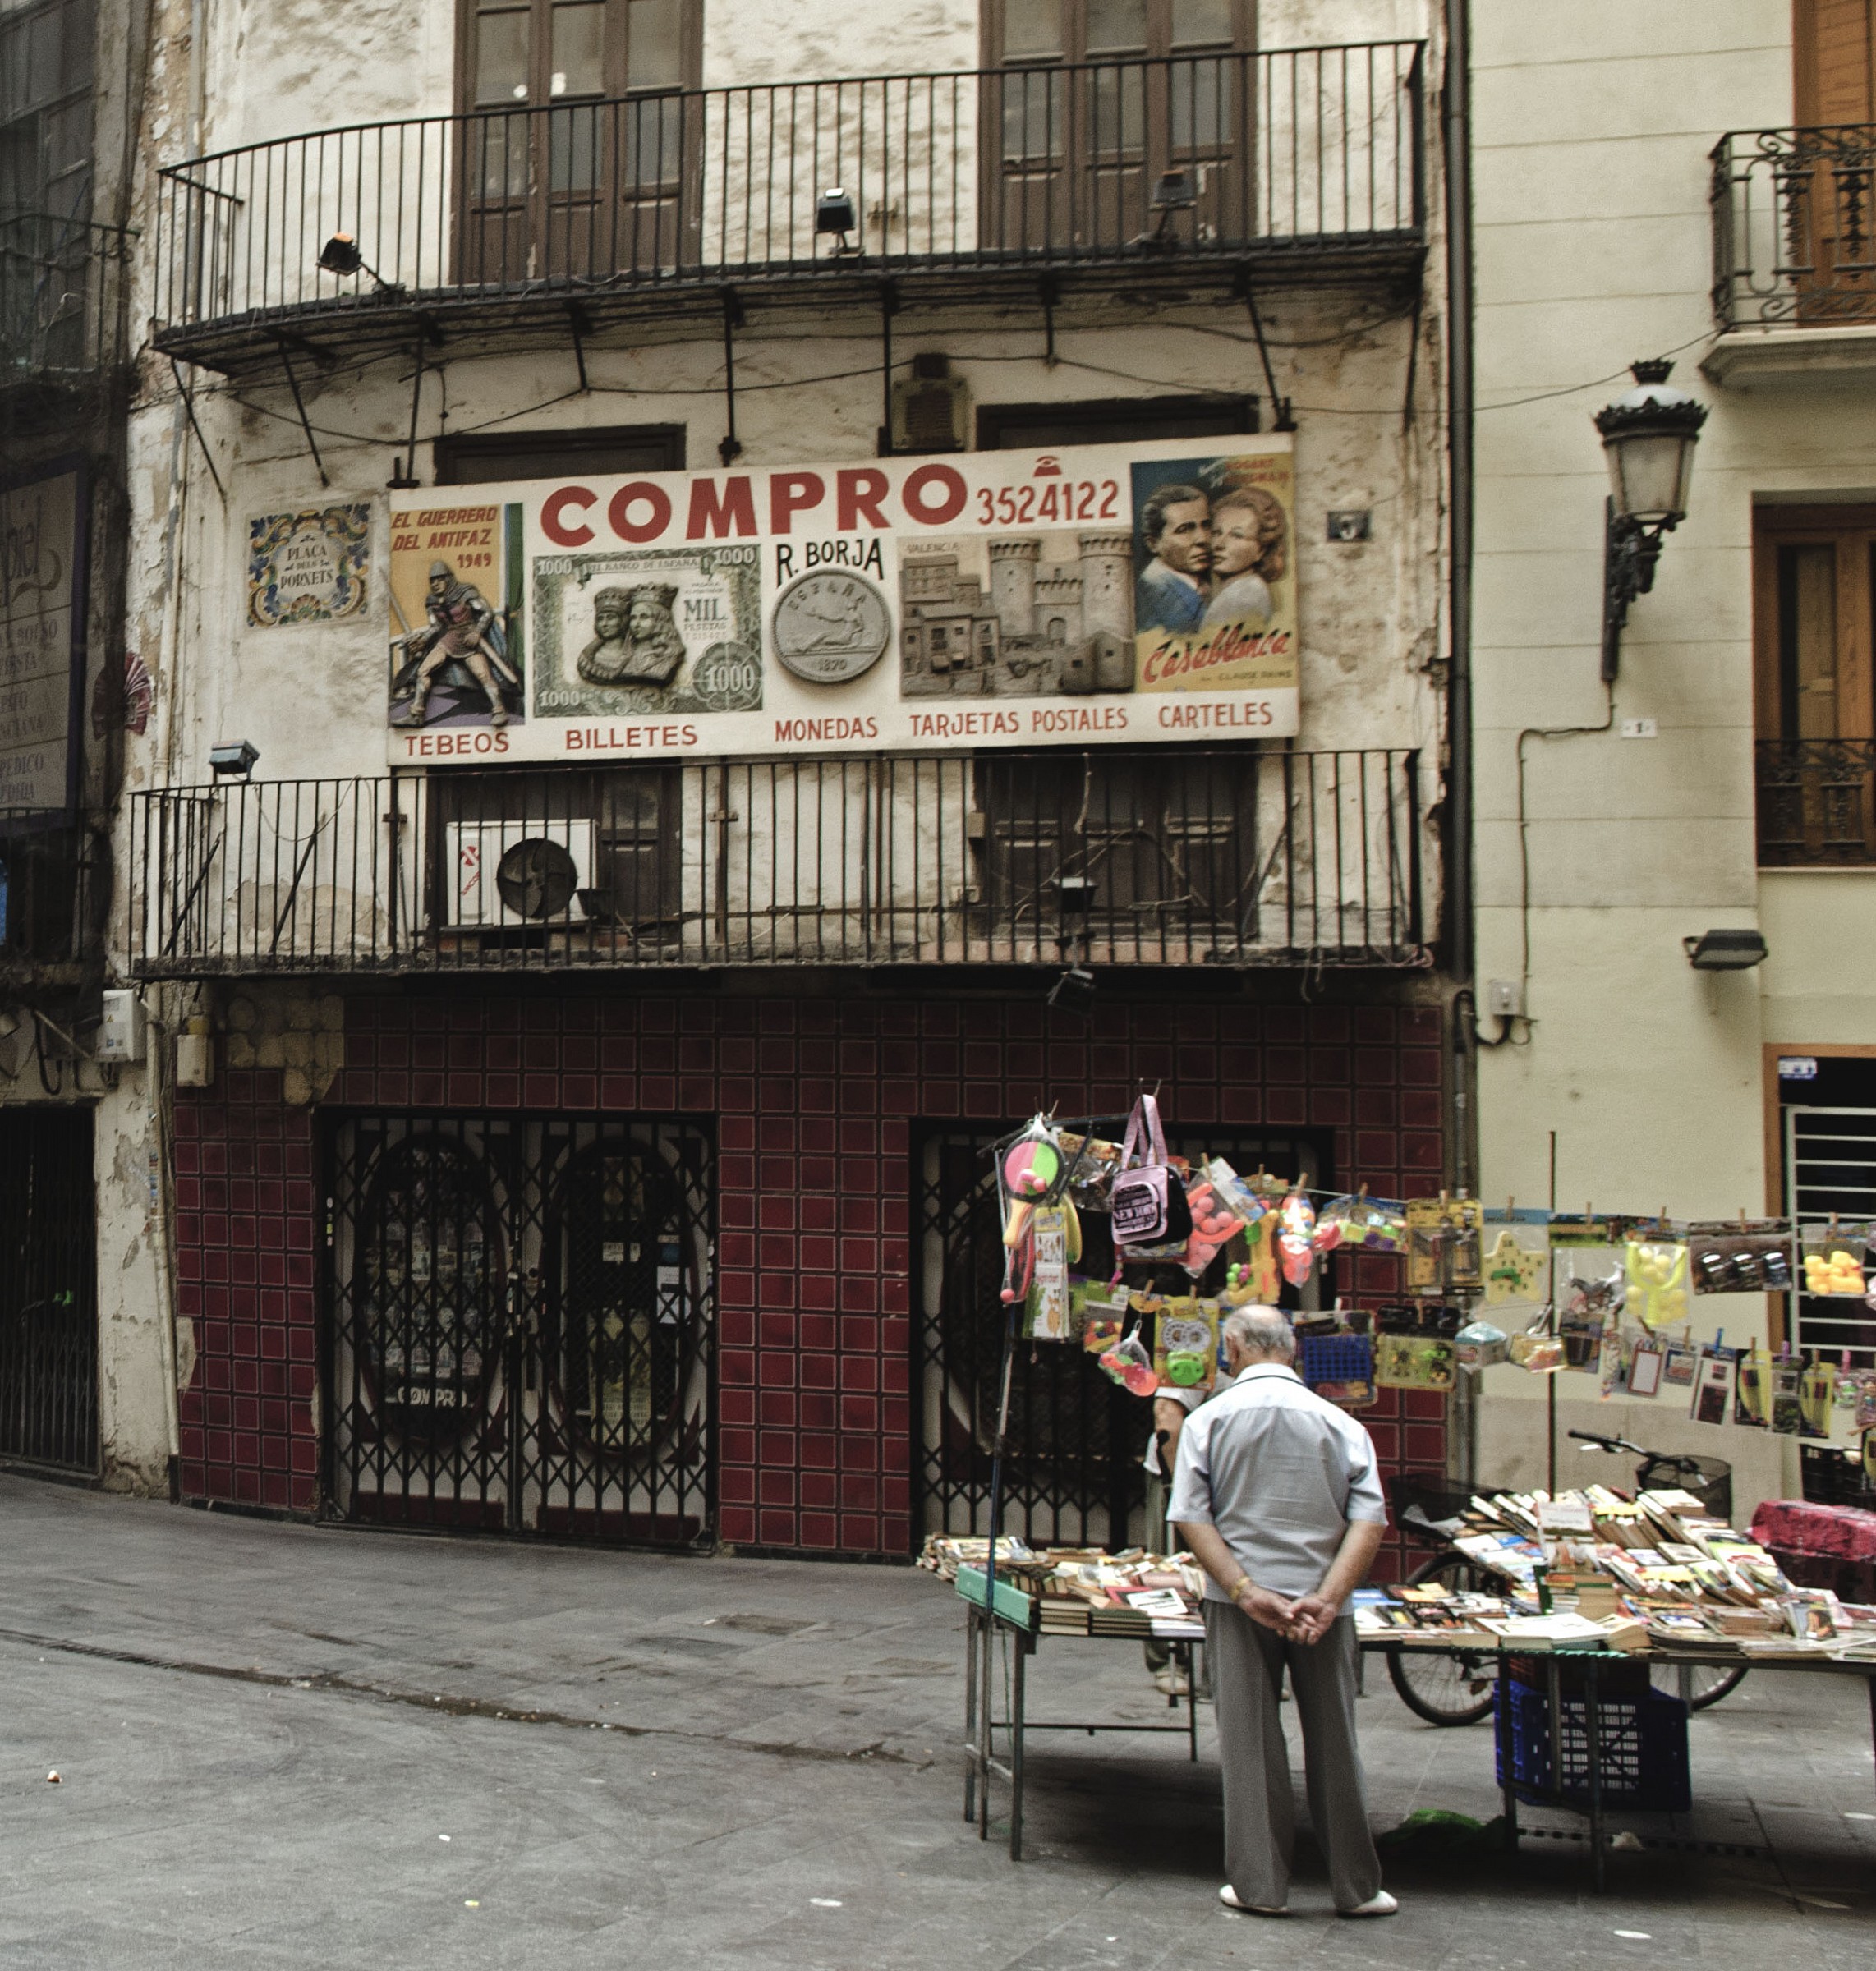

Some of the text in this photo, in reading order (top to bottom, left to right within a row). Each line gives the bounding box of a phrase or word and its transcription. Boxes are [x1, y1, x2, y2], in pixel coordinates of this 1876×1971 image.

[391, 507, 498, 529] EL GUERRERO
[540, 463, 1119, 548] COMPRO 3524122
[391, 528, 493, 551] DEL ANTIFAZ
[457, 553, 492, 568] 1949
[537, 558, 572, 576] 1000
[605, 560, 640, 571] BANCO
[714, 547, 756, 566] 1000
[776, 535, 885, 589] R. BORJA
[684, 598, 726, 623] MIL
[1143, 621, 1291, 684] Casablanca
[706, 664, 756, 693] 1000
[539, 690, 582, 707] 1000
[775, 715, 879, 742] MONEDAS
[908, 702, 1273, 738] TARJETAS POSTALES CARTELES
[404, 732, 510, 757] TEBEOS
[565, 724, 699, 751] BILLETES
